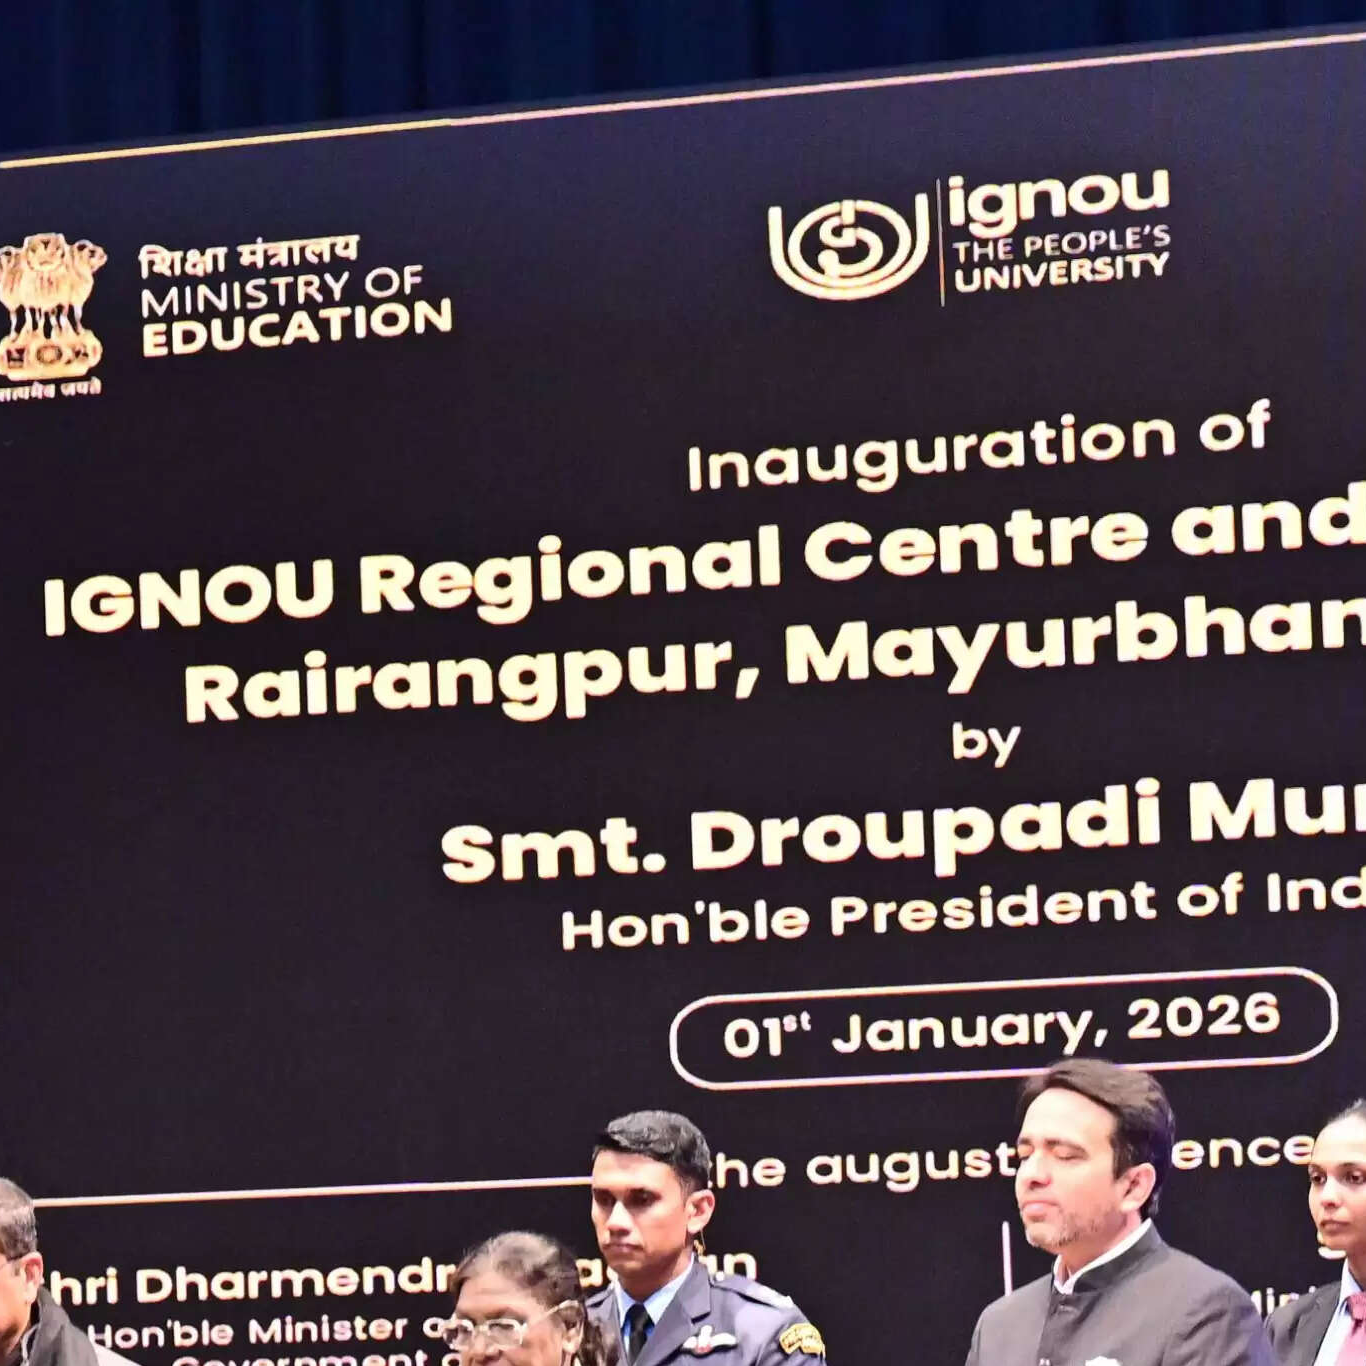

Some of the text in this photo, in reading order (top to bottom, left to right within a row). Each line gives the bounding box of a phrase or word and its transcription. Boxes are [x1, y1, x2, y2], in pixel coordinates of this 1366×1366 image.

[947, 168, 1172, 240] ignou
[136, 233, 361, 281] शिक्षा मंत्रालय
[951, 236, 1014, 265] THE
[953, 251, 1171, 294] UNIVERSITY
[140, 263, 424, 320] MINISTRY OF
[140, 299, 453, 358] EDUCATION
[687, 397, 1272, 494] Inauguration of
[43, 557, 335, 638] IGNOU
[358, 523, 782, 626] Regional
[803, 508, 1150, 582] Centre
[184, 639, 761, 724] Rairangpur,
[951, 721, 1022, 769] by
[440, 816, 668, 884] Smt.
[689, 776, 1162, 879] Droupadi
[829, 880, 1158, 937] President
[1176, 870, 1245, 918] of
[830, 1009, 1109, 1057] January,
[1126, 990, 1281, 1040] 2026
[708, 1150, 787, 1189] he
[806, 1141, 1017, 1193] august
[50, 1256, 457, 1306] hri Dharmendr
[248, 1313, 409, 1344] Minister
